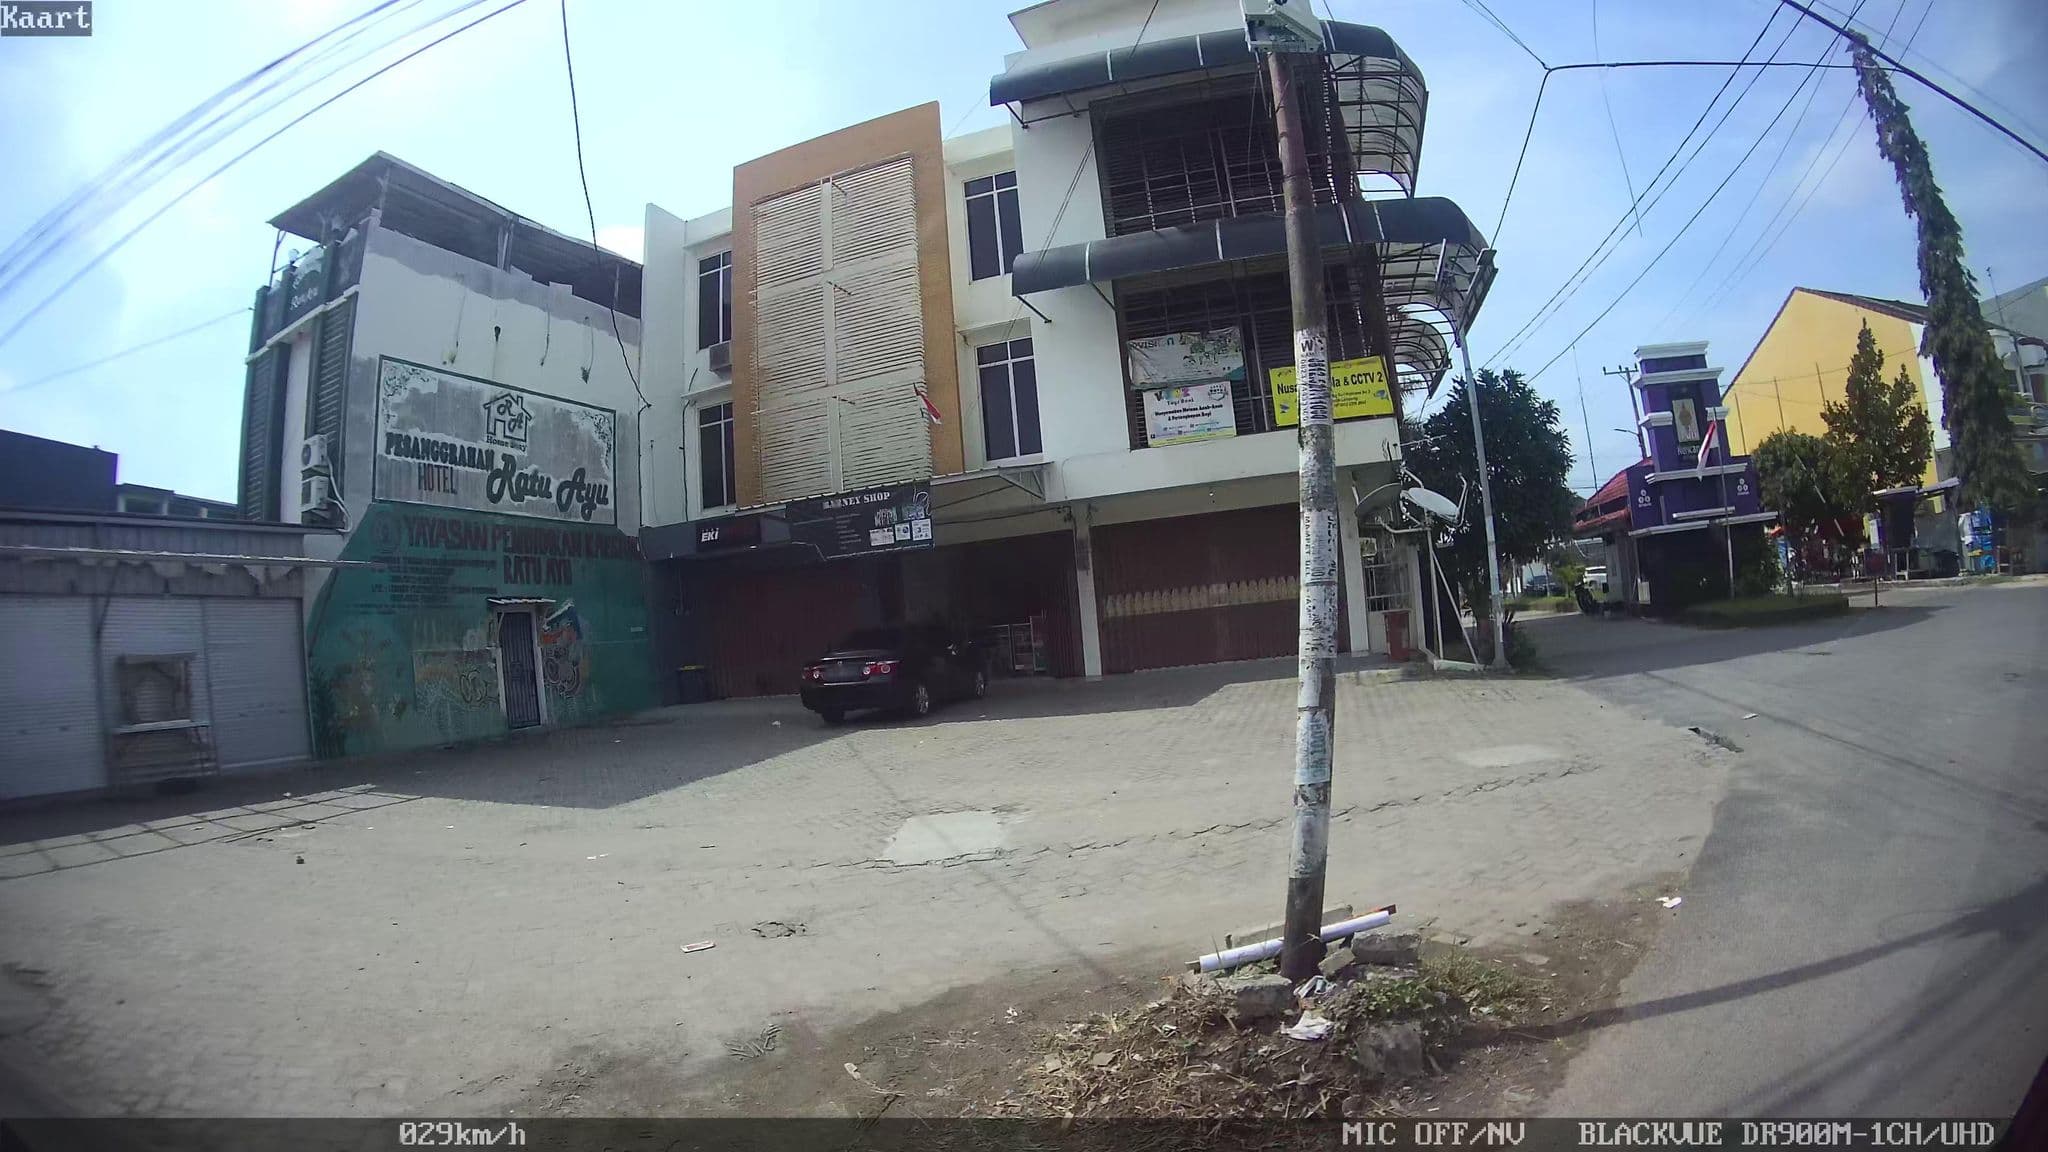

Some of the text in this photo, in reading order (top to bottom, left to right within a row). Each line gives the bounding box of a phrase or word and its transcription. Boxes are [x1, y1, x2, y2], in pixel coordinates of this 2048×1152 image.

[1344, 377, 1350, 386] &
[1351, 372, 1374, 385] CCTV
[1377, 371, 1383, 382] 2
[417, 463, 458, 495] HOTEL
[486, 453, 609, 521] Ratu Ayu
[863, 491, 890, 504] SHOP
[503, 556, 541, 585] RATU
